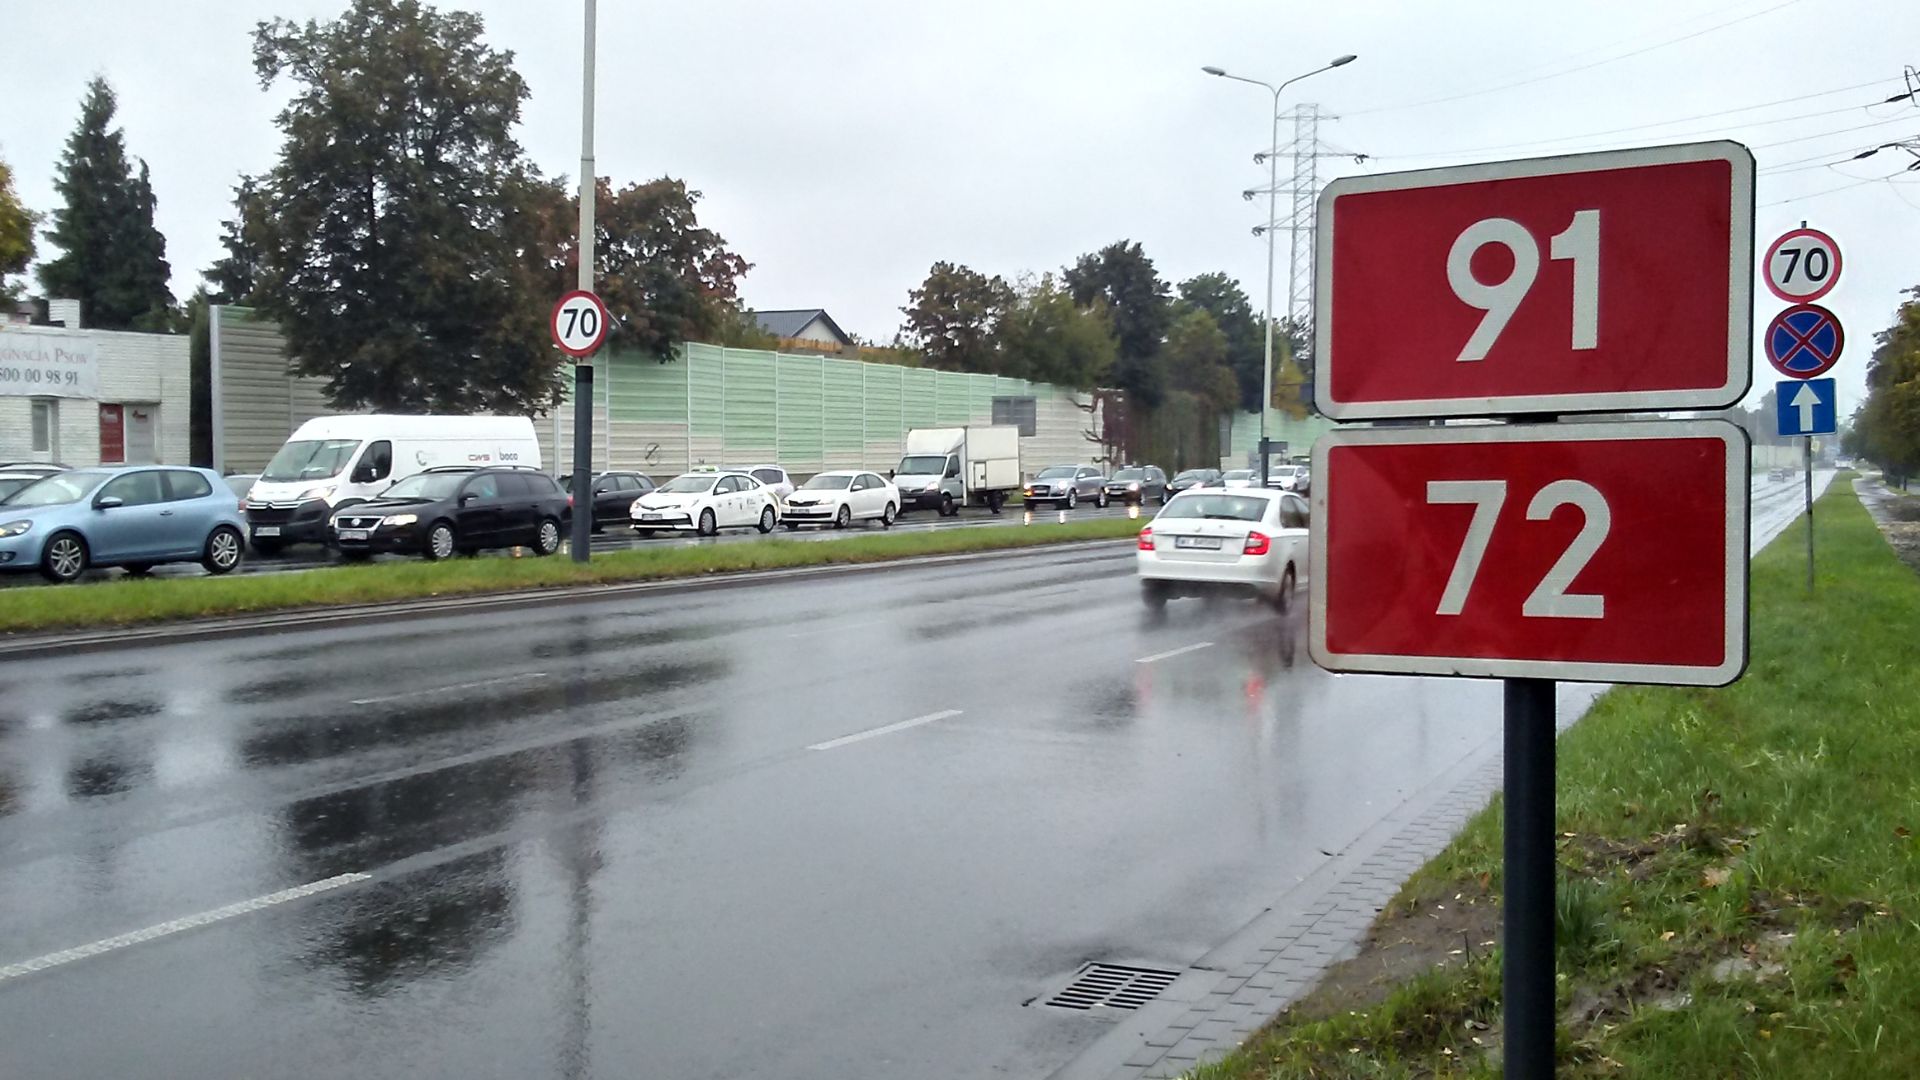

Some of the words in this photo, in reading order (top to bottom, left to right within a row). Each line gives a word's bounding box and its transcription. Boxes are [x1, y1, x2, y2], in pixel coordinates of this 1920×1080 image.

[1779, 247, 1829, 284] 70
[1446, 209, 1600, 362] 91
[563, 308, 598, 339] 70
[46, 369, 61, 385] 98
[65, 371, 78, 385] 91
[1426, 479, 1611, 618] 72
